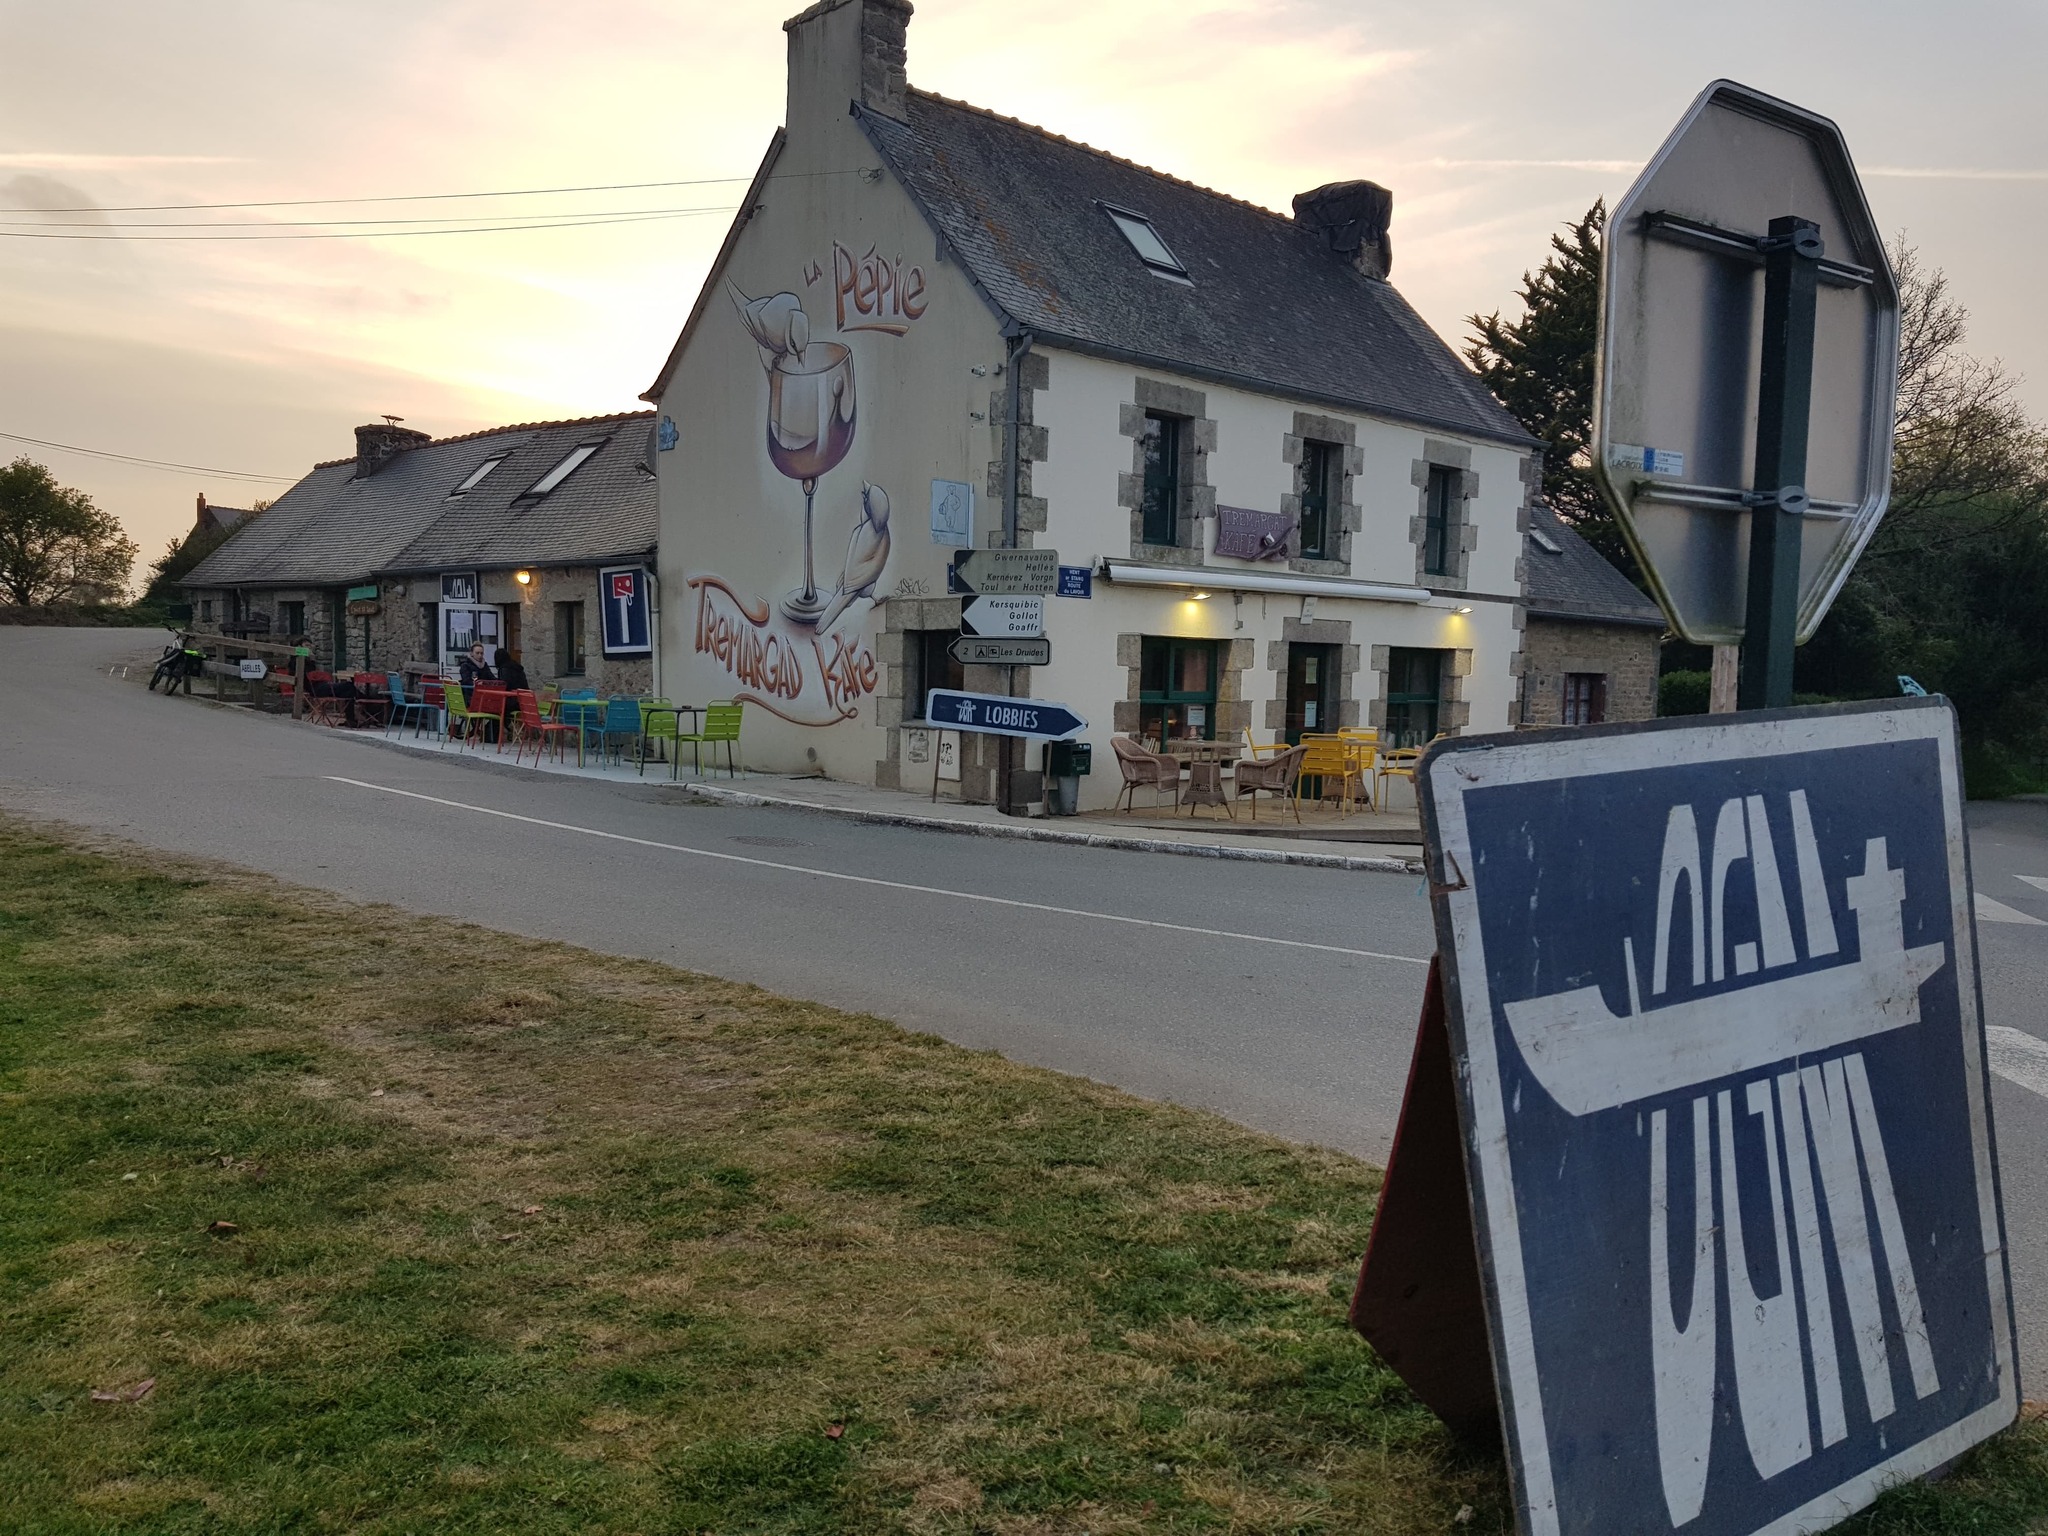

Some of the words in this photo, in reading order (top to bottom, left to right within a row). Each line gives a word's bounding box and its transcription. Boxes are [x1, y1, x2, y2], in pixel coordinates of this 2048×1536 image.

[1612, 459, 1643, 471] LACROIX
[981, 583, 999, 591] Toul
[1023, 583, 1054, 591] Hotten
[989, 600, 1039, 609] Kersquibic
[1009, 611, 1038, 620] Gollot
[1008, 623, 1038, 631] Goaffr
[963, 647, 969, 655] 2
[1001, 648, 1013, 656] Les
[1016, 648, 1044, 657] Druides
[985, 705, 1039, 729] LOBBIES
